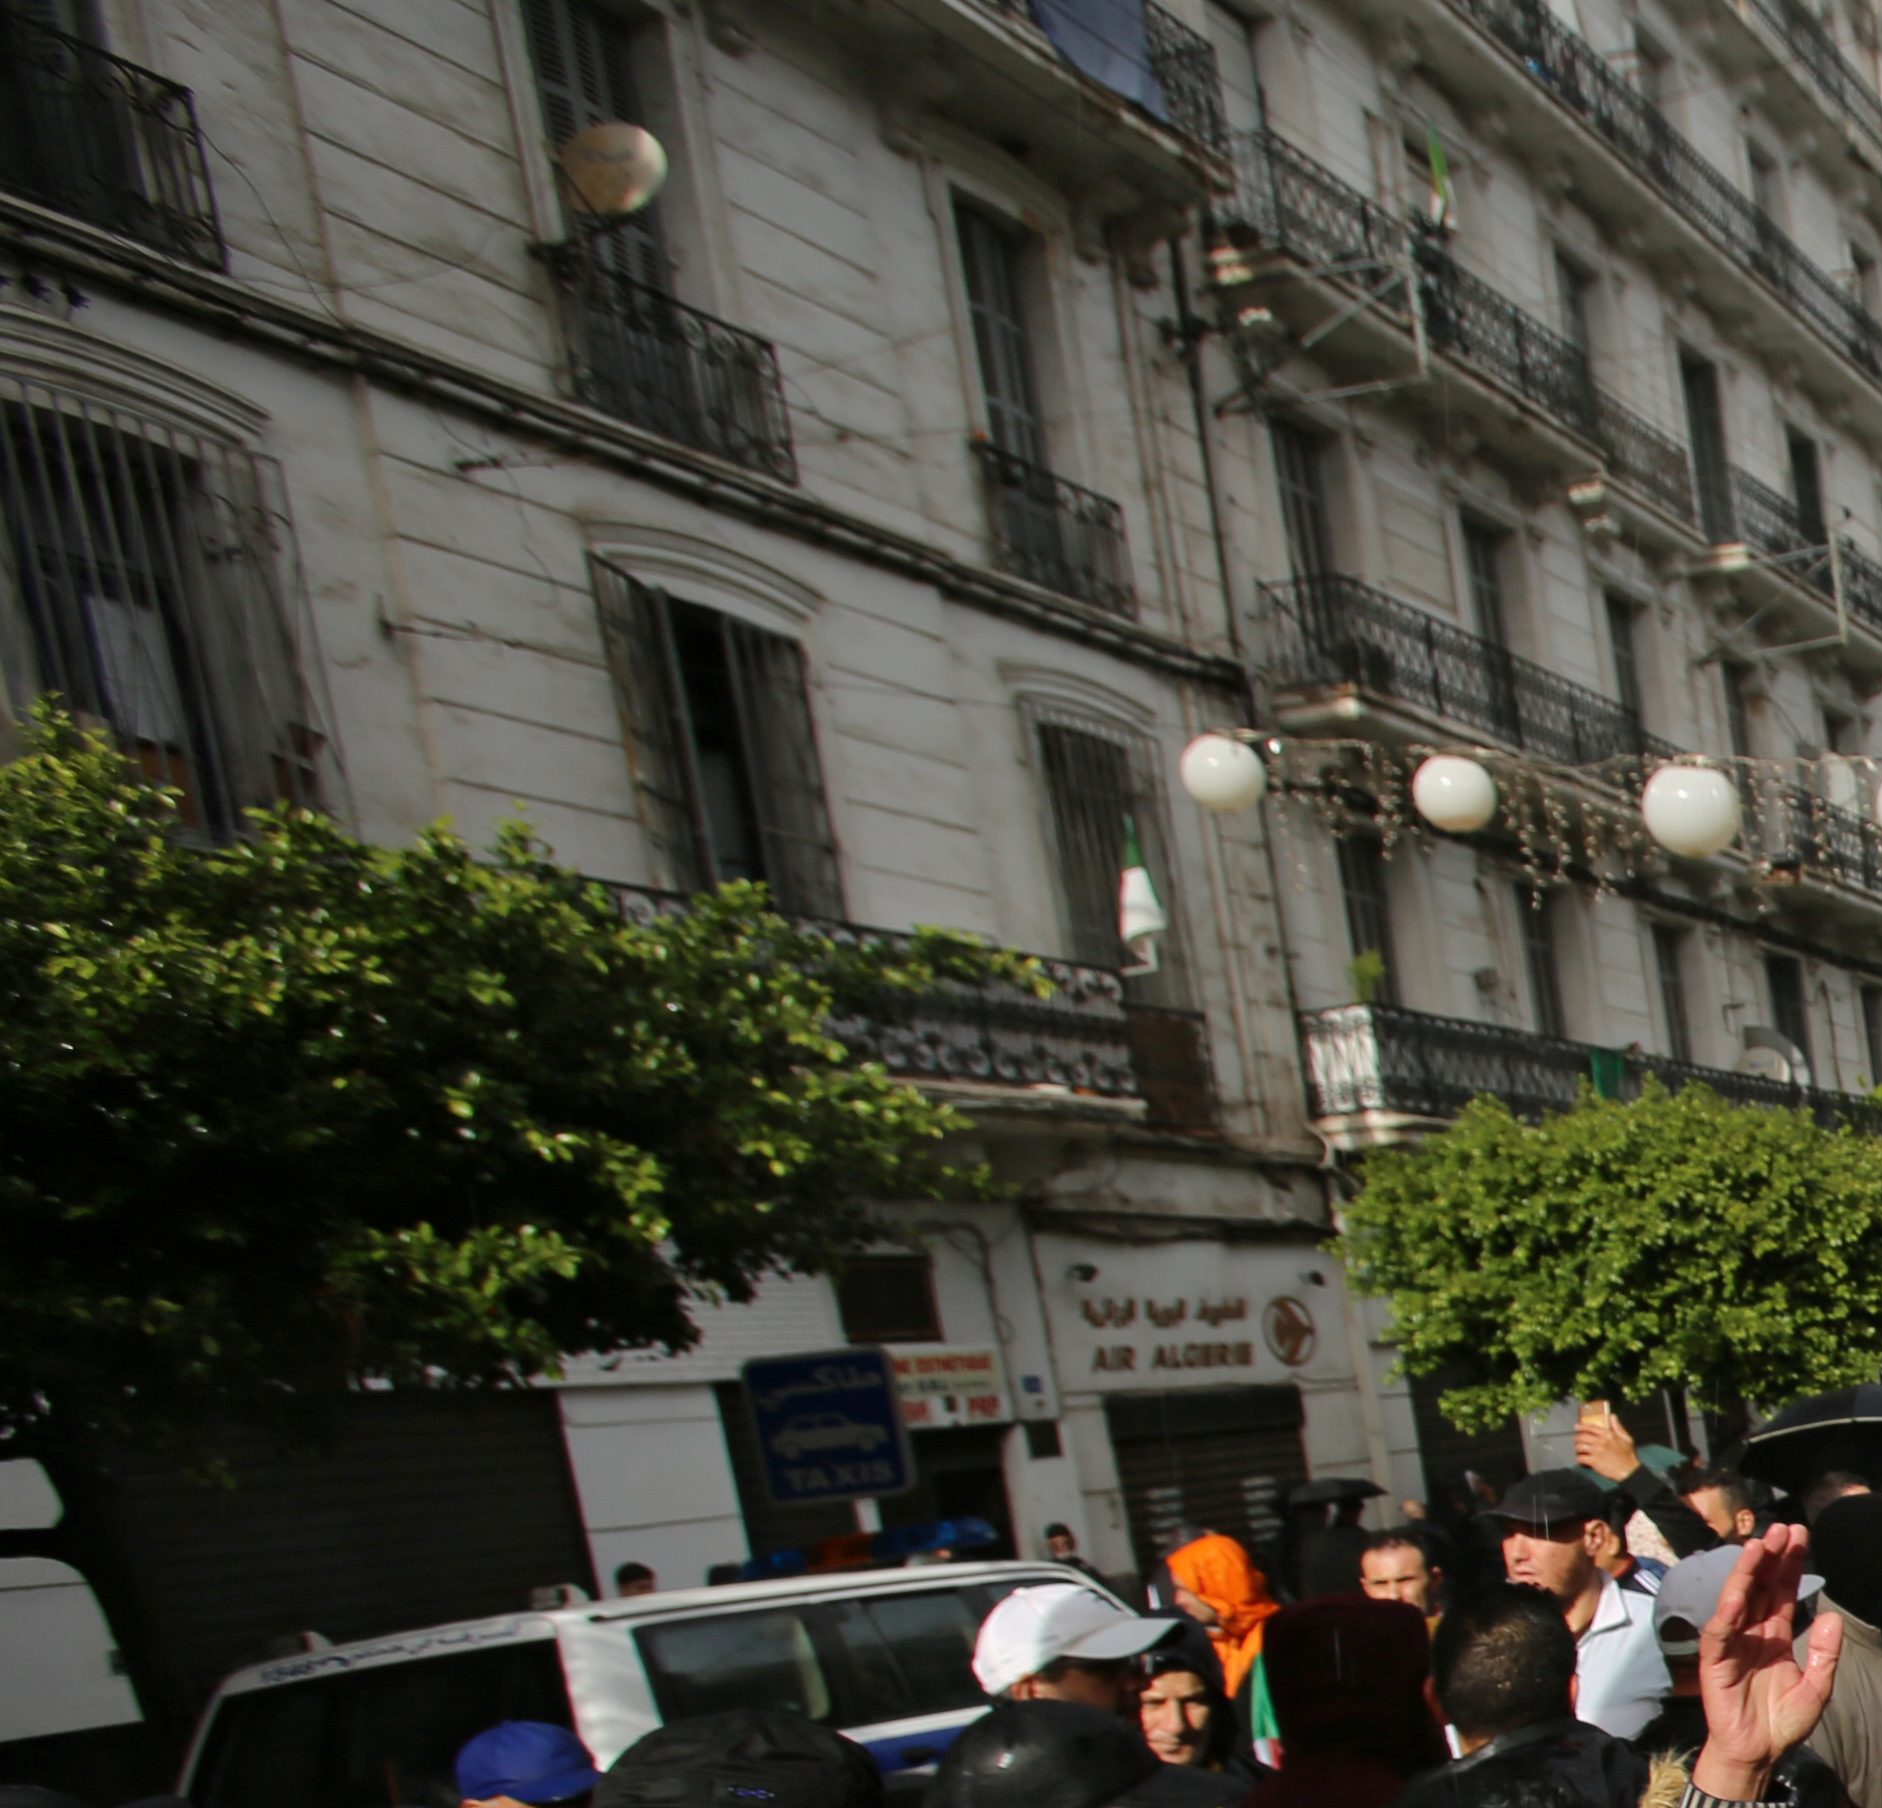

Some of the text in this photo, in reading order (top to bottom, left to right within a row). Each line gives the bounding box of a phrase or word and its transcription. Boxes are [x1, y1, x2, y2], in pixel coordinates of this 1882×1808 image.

[1093, 1342, 1254, 1372] AIR ALGERIE
[784, 1460, 895, 1491] TAXIS
